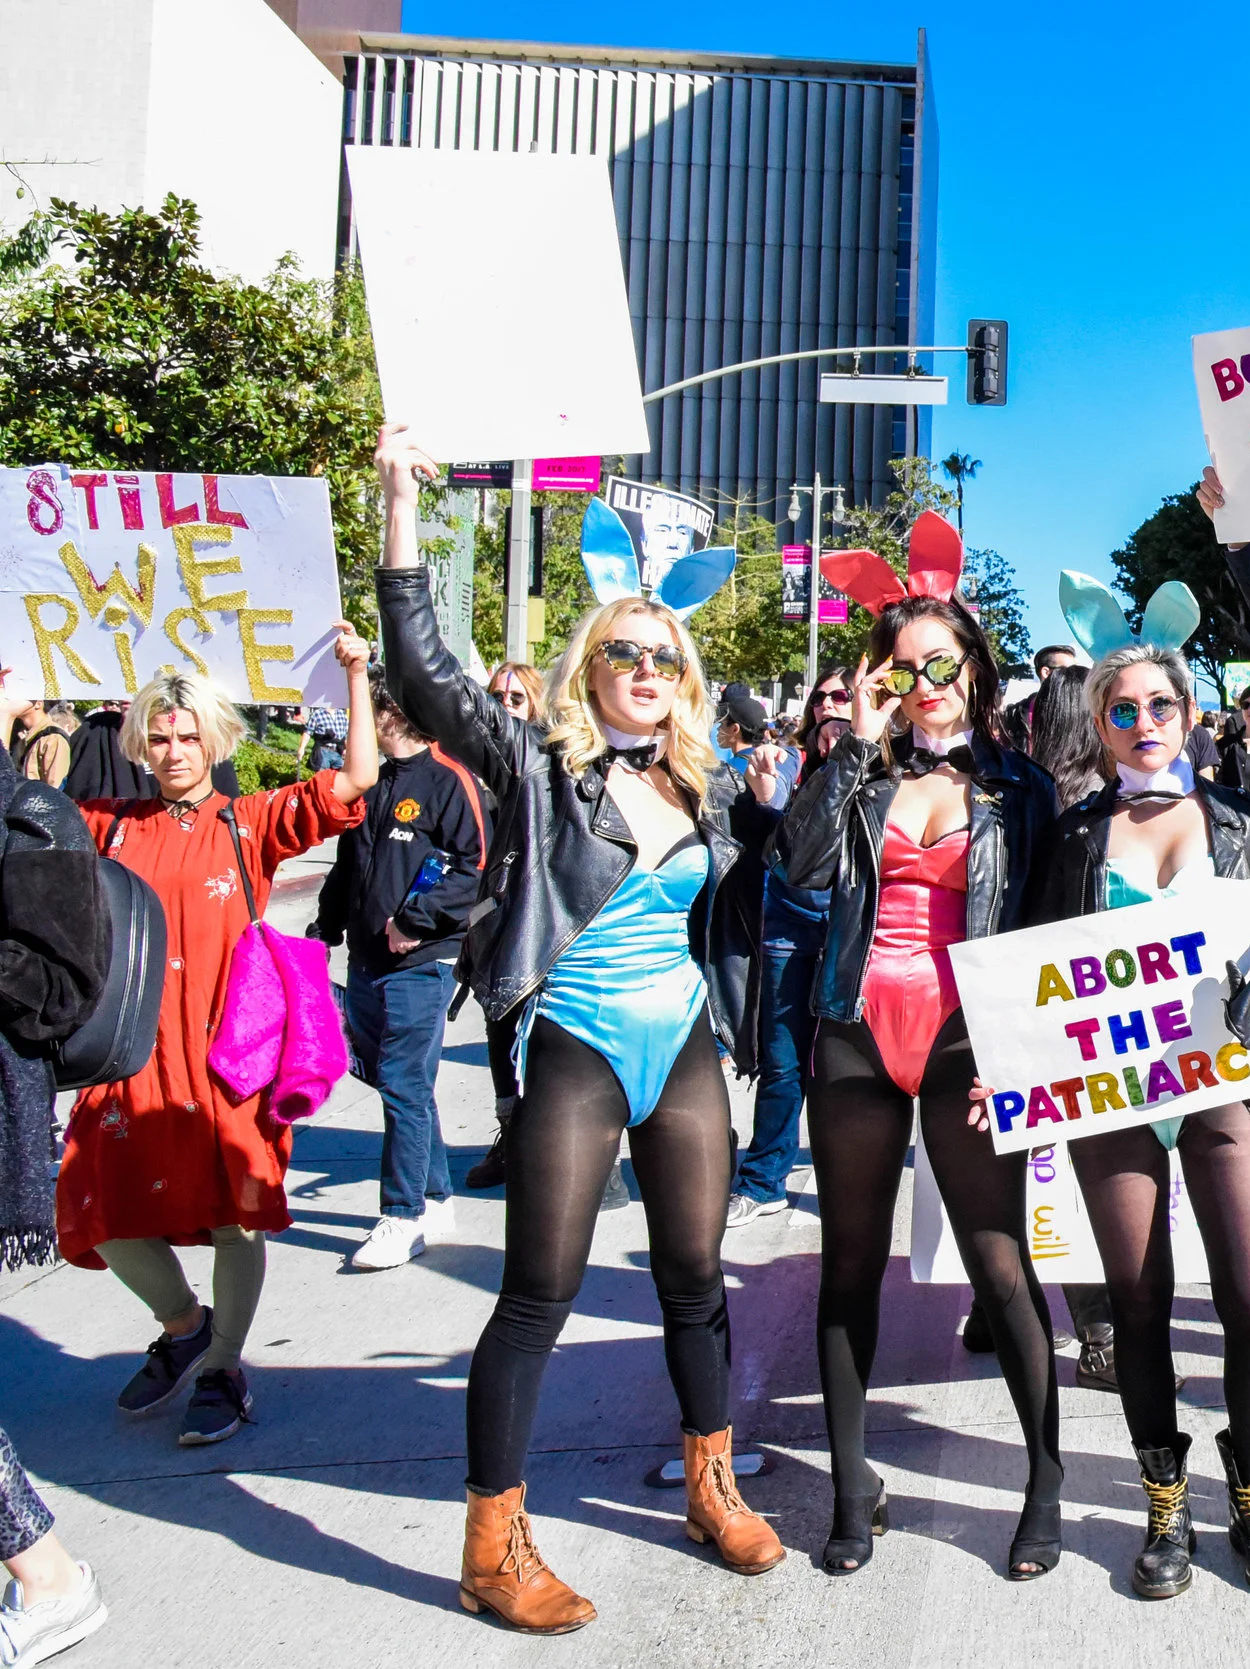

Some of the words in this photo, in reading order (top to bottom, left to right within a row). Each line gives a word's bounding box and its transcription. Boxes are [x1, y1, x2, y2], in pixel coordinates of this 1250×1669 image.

[58, 524, 249, 630] WE
[1035, 931, 1206, 1007] ABORT
[1064, 999, 1193, 1061] THE
[1030, 1205, 1071, 1261] will
